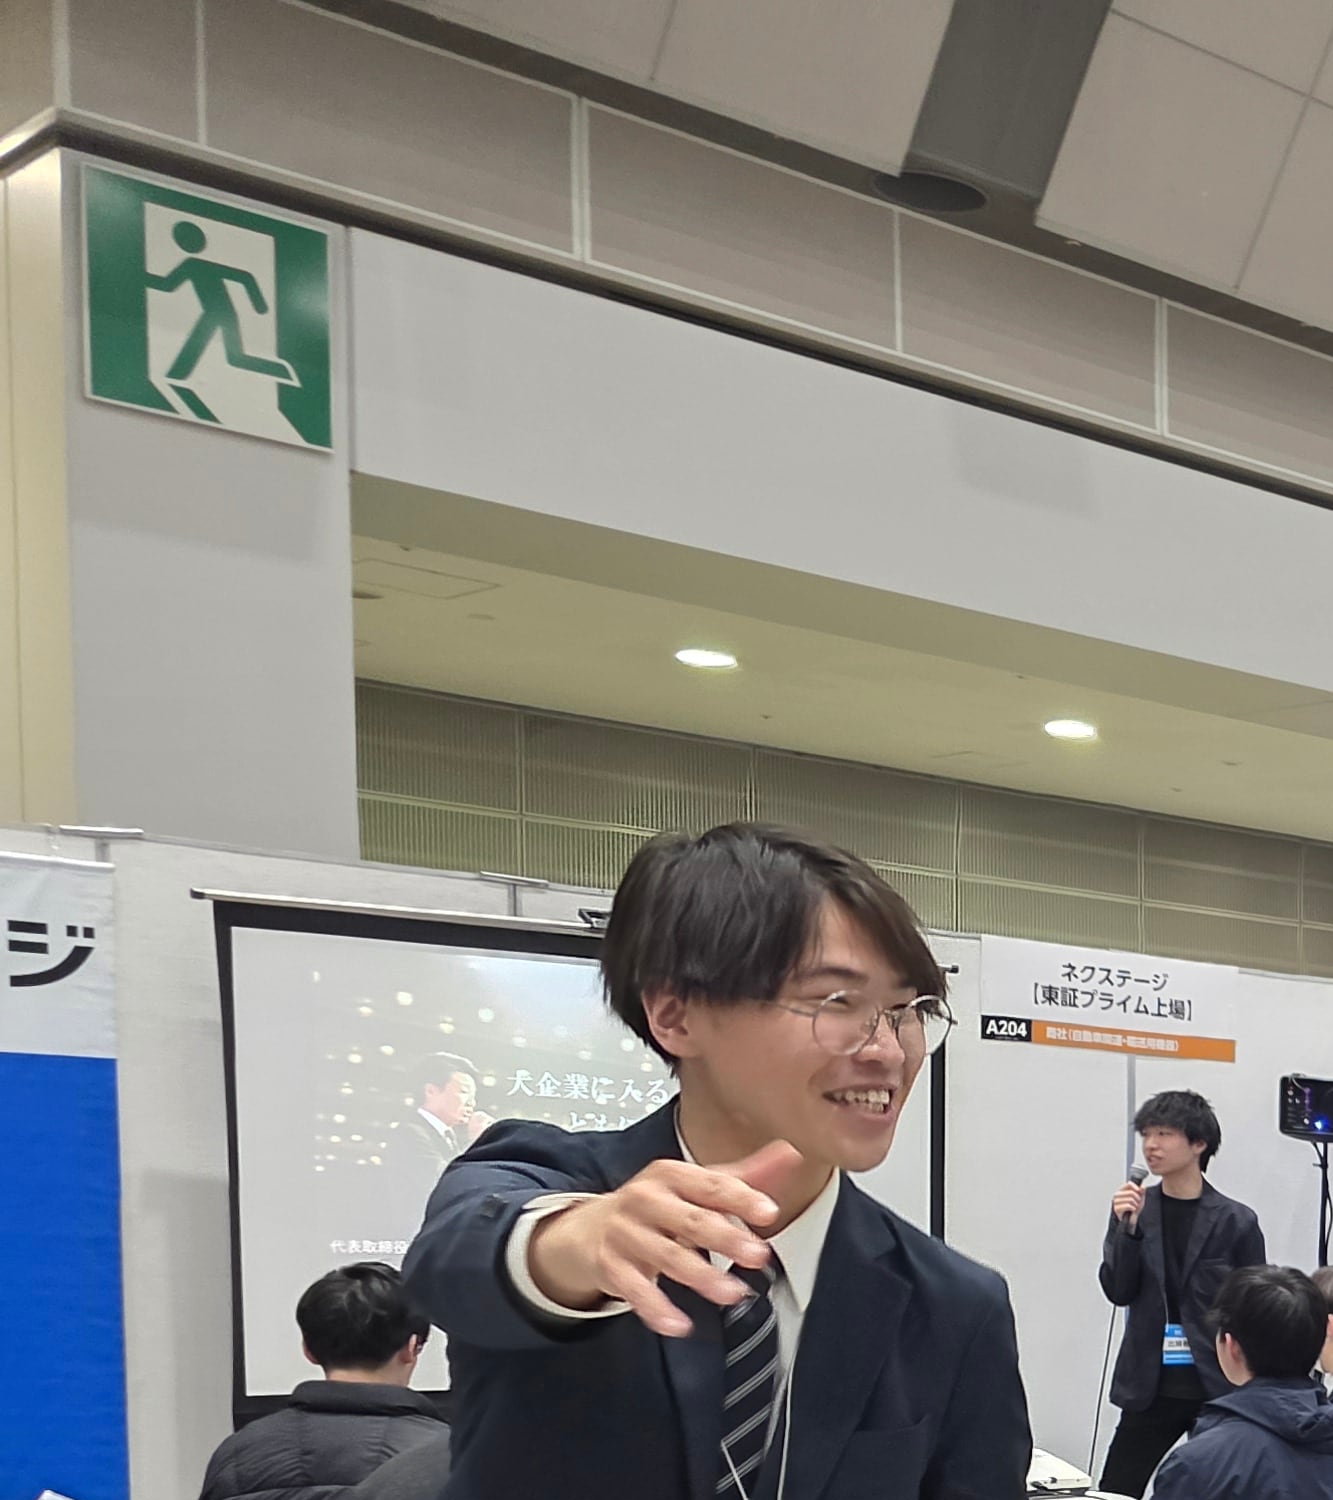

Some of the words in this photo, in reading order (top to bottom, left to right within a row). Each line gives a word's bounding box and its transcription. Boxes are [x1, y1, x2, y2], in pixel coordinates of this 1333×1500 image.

[7, 919, 96, 988] ジ
[1061, 962, 1170, 992] ネクステージ
[1031, 982, 1194, 1022] 【東証プライム上場】
[986, 1019, 1028, 1038] A204
